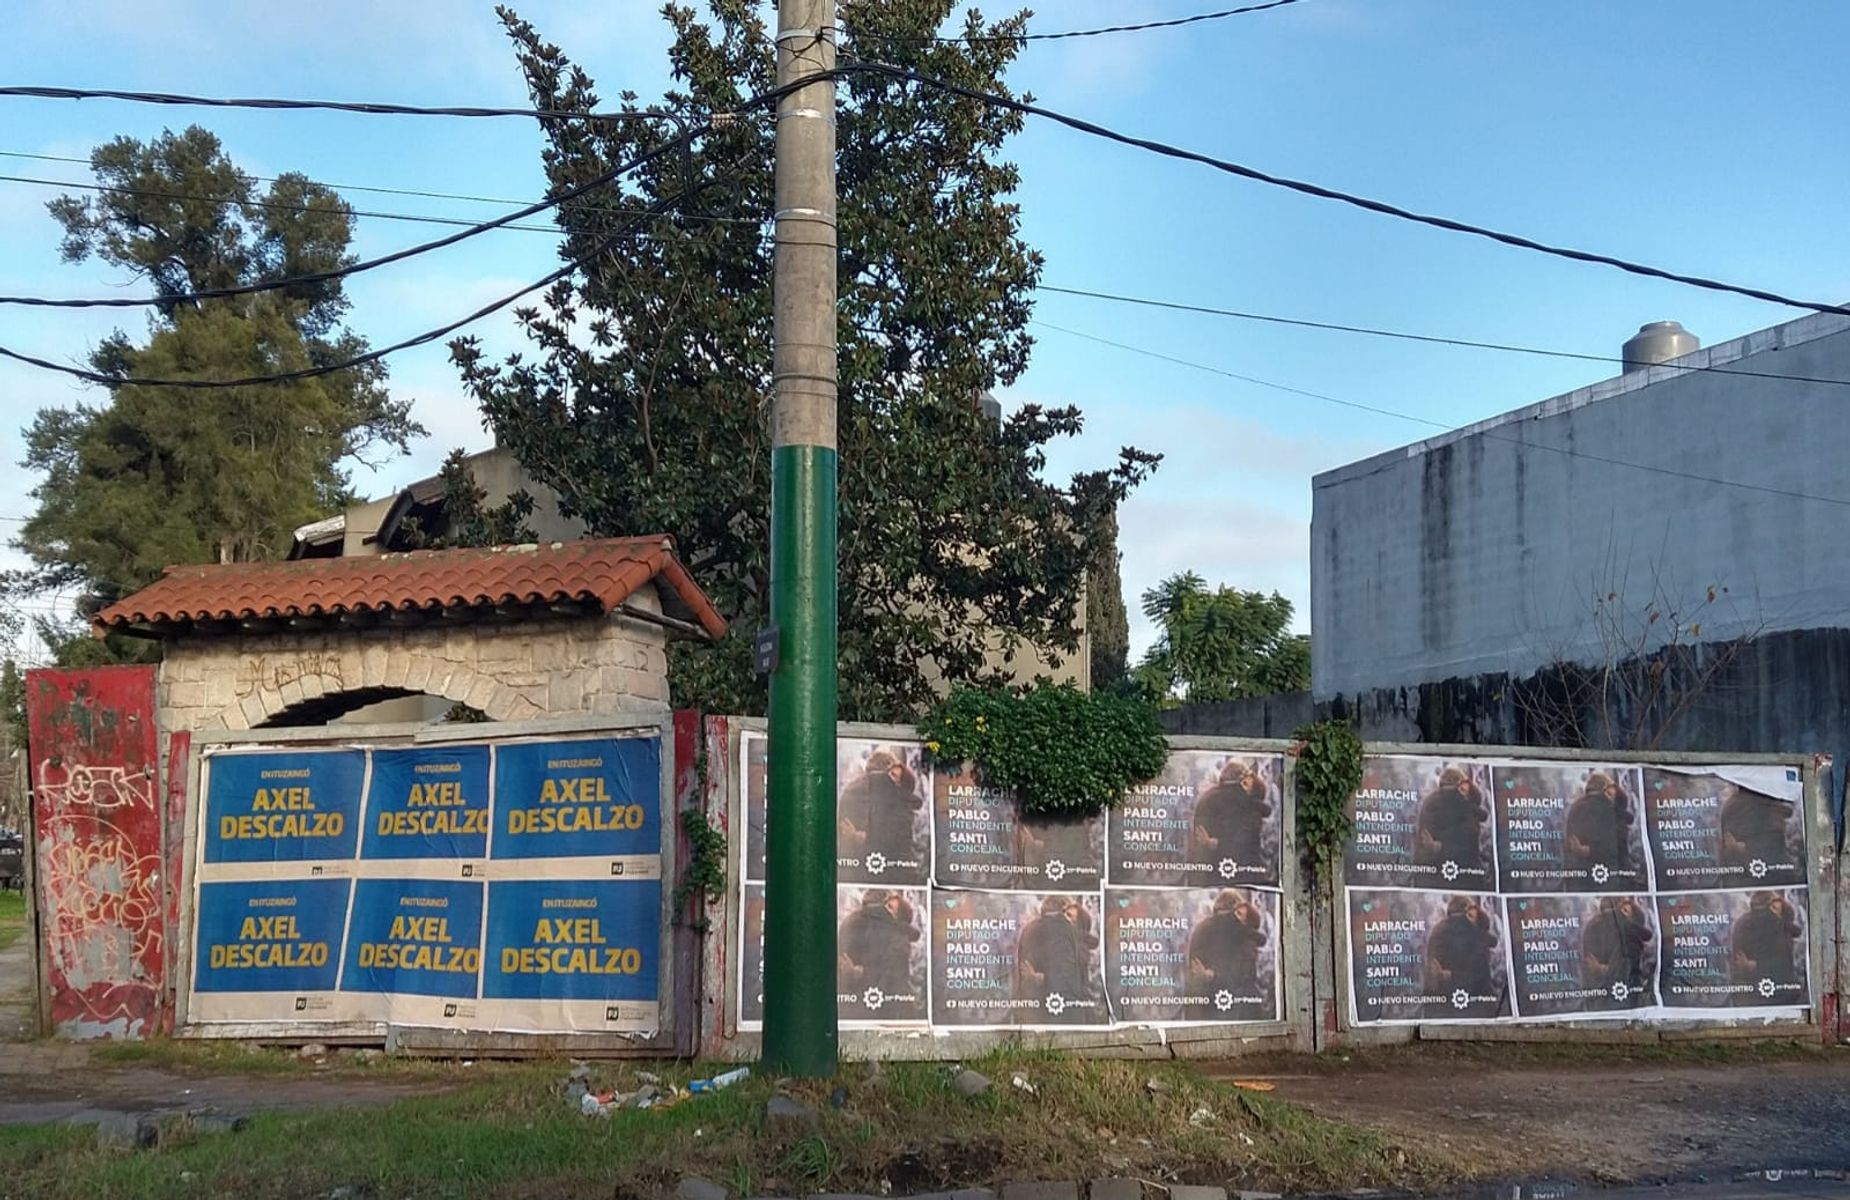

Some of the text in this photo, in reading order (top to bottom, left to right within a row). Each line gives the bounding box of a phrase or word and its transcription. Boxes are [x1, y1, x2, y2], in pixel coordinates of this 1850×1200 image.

[407, 782, 466, 807] AXEL
[540, 778, 611, 803] AXEL
[949, 786, 1018, 798] LARRACHE
[1356, 789, 1417, 801] LARRACHE
[252, 787, 315, 811] AXEL
[1124, 796, 1177, 805] DIPUTADO
[1507, 798, 1564, 808] LARRACHE
[1656, 798, 1718, 808] LARRACHE
[1356, 800, 1403, 809] DIPUTADO
[949, 809, 990, 821] PABLO
[1124, 808, 1167, 819] PABLO
[1356, 812, 1394, 821] PABLO
[1508, 809, 1551, 817] DIPUTADO
[508, 805, 644, 834] DESCALZO
[1123, 819, 1189, 829] INTENDENTE
[1509, 820, 1543, 829] PABLO
[220, 812, 344, 839] DESCALZO
[949, 821, 1013, 832] INTENDENTE
[1356, 822, 1414, 833] INTENDENTE
[1658, 820, 1694, 830] PABLO
[950, 832, 987, 844] SANTI
[1123, 831, 1162, 842] SANTI
[1509, 831, 1561, 839] INTENDENTE
[1660, 828, 1716, 838] INTENDENTE
[1357, 834, 1390, 844] SANTI
[950, 844, 1004, 853] CONCEJAL
[1123, 842, 1177, 851] CONCEJAL
[1357, 845, 1406, 854] CONCEJAL
[1510, 842, 1541, 851] SANTI
[1662, 841, 1694, 850] SANTI
[1511, 852, 1556, 860] CONCEJAL
[991, 865, 1040, 874] ENCUENTRO
[1134, 862, 1213, 872] NUEVO ENCUENTRO
[1367, 863, 1392, 871] NUEVO
[1394, 864, 1437, 873] ENCUENTRO
[1676, 866, 1744, 876] NUEVO ENCUENTRO
[1119, 918, 1189, 929] LARRACHE
[1521, 918, 1580, 929] LARRACHE
[1672, 914, 1730, 924] LARRACHE
[240, 916, 300, 940] AXEL
[389, 916, 452, 942] AXEL
[946, 920, 1016, 930] LARRACHE
[1364, 921, 1425, 932] LARRACHE
[534, 918, 606, 944] AXEL
[947, 930, 1000, 940] DIPUTADO
[1120, 930, 1172, 939] DIPUTADO
[1523, 929, 1566, 938] DIPUTADO
[1524, 941, 1559, 952] PABLO
[1674, 937, 1709, 947] PABLO
[947, 944, 989, 954] PABLO
[1120, 942, 1162, 953] PABLO
[1366, 944, 1402, 954] PABLO
[210, 942, 328, 968] DESCALZO
[359, 944, 480, 972] DESCALZO
[947, 955, 1013, 965] INTENDENTE
[1120, 954, 1185, 962] INTENDENTE
[1366, 955, 1421, 964] INTENDENTE
[501, 948, 641, 974] DESCALZO
[1674, 959, 1707, 968] SANTI
[947, 967, 985, 978] SANTI
[1121, 966, 1158, 976] SANTI
[1366, 967, 1400, 978] SANTI
[1526, 963, 1558, 974] SANTI
[947, 979, 1001, 989] CONCEJAL
[1121, 977, 1175, 987] CONCEJAL
[1565, 989, 1607, 998] ENCUENTRO
[1710, 985, 1753, 993] ENCUENTRO
[958, 1000, 1040, 1008] NUEVO ENCUENTRO
[1132, 997, 1210, 1005] NUEVO ENCUENTRO
